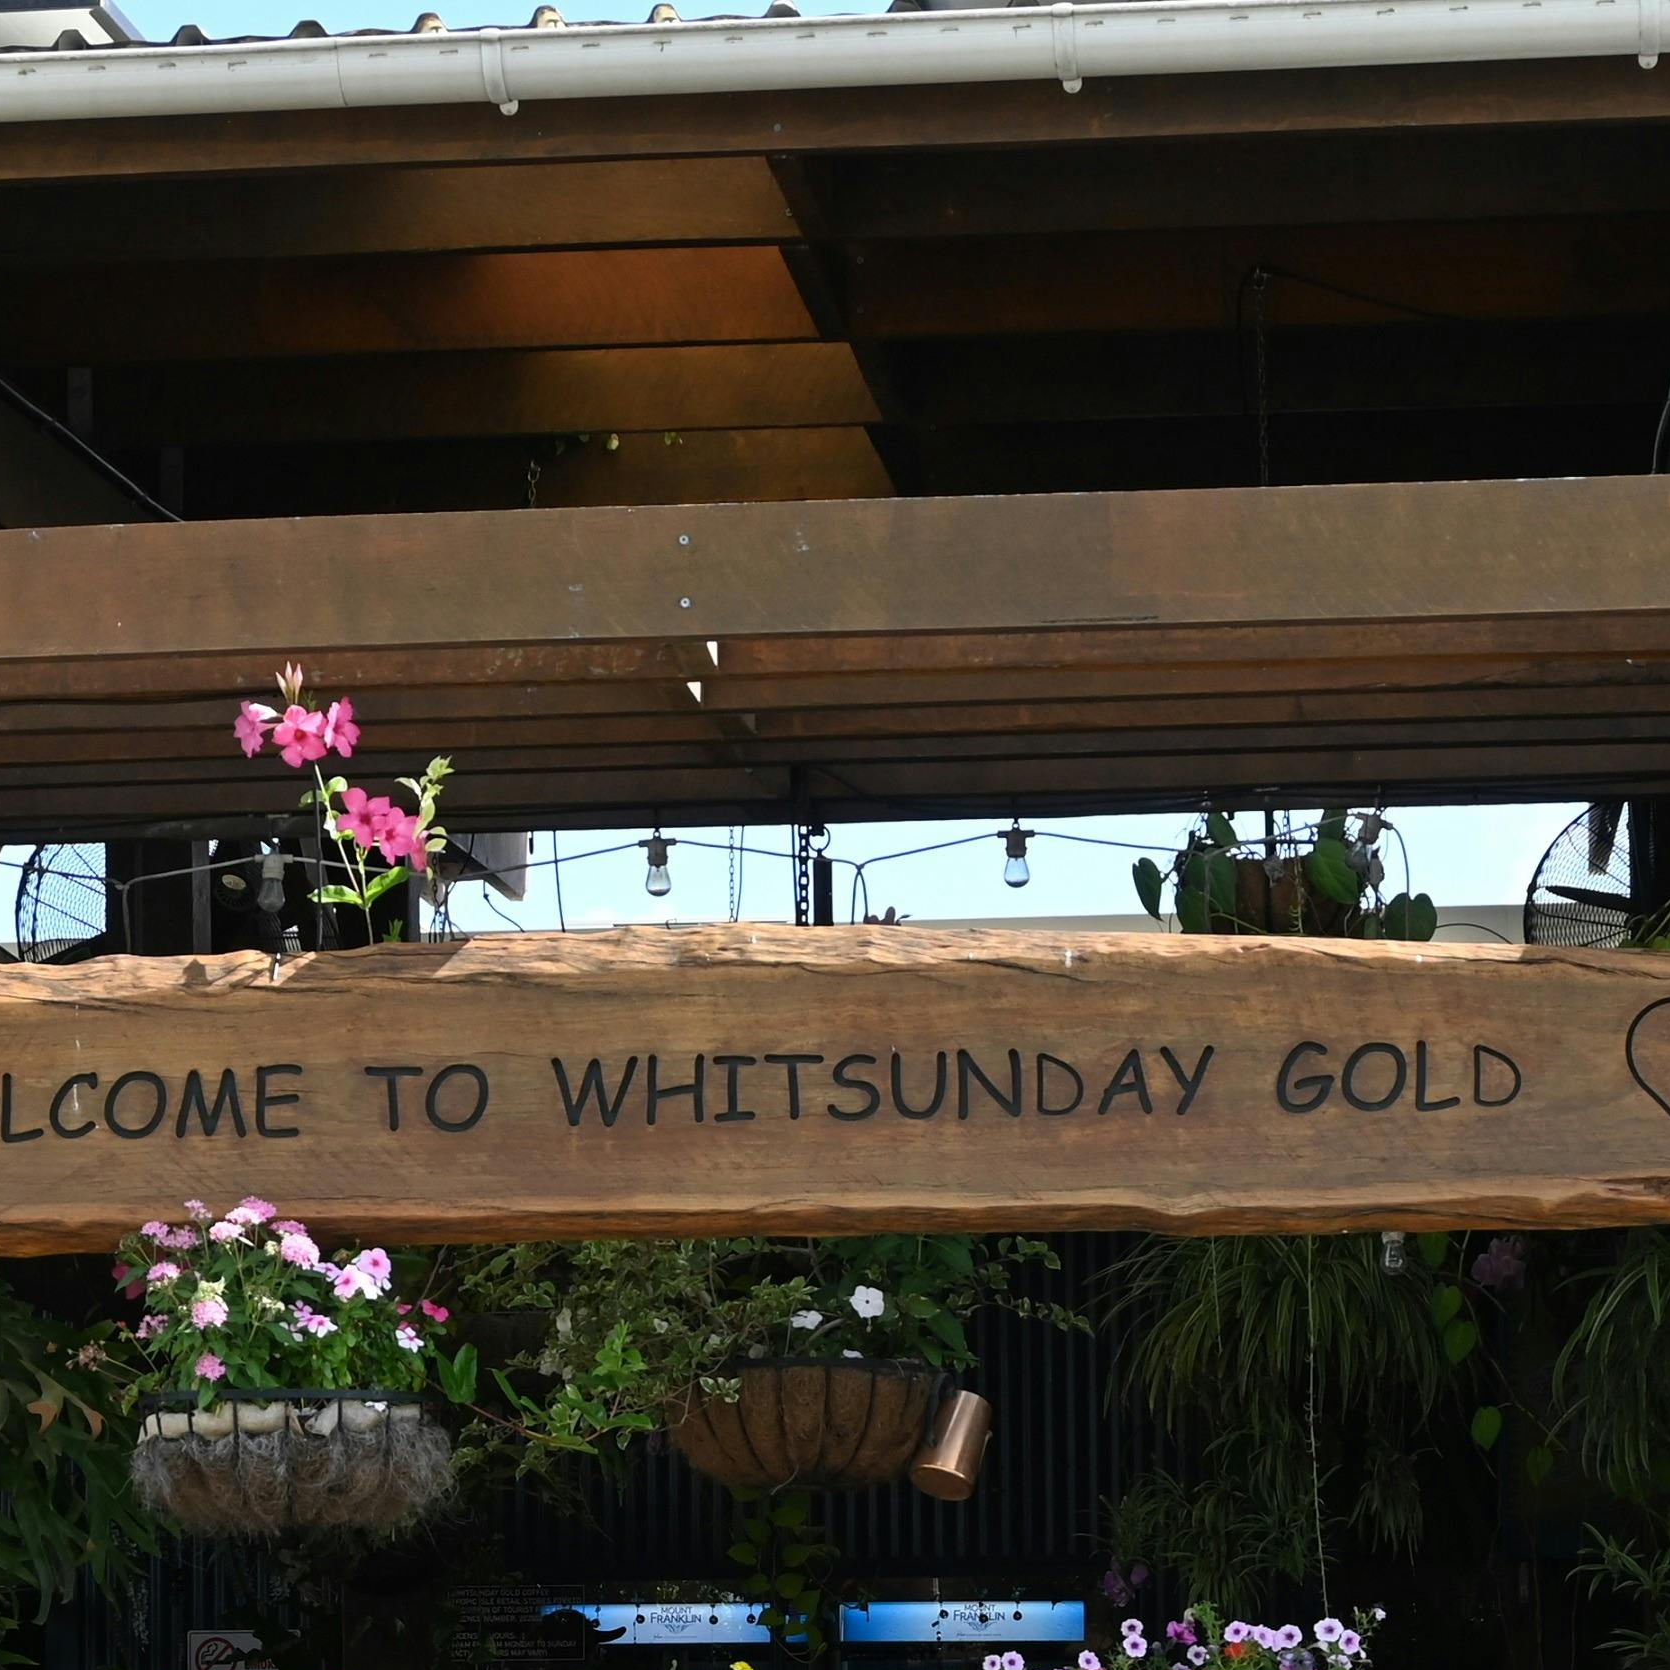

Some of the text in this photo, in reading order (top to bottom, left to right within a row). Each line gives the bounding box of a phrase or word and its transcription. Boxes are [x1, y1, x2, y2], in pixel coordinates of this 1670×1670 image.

[363, 1064, 490, 1132] TO
[549, 1044, 1215, 1127] WHITSUNDAY
[1274, 1040, 1523, 1114] GOLD
[660, 1606, 693, 1615] MOUNT
[964, 1603, 996, 1611] MONT
[650, 1611, 702, 1624] FRANKLIN
[953, 1609, 1006, 1621] FRANLIN
